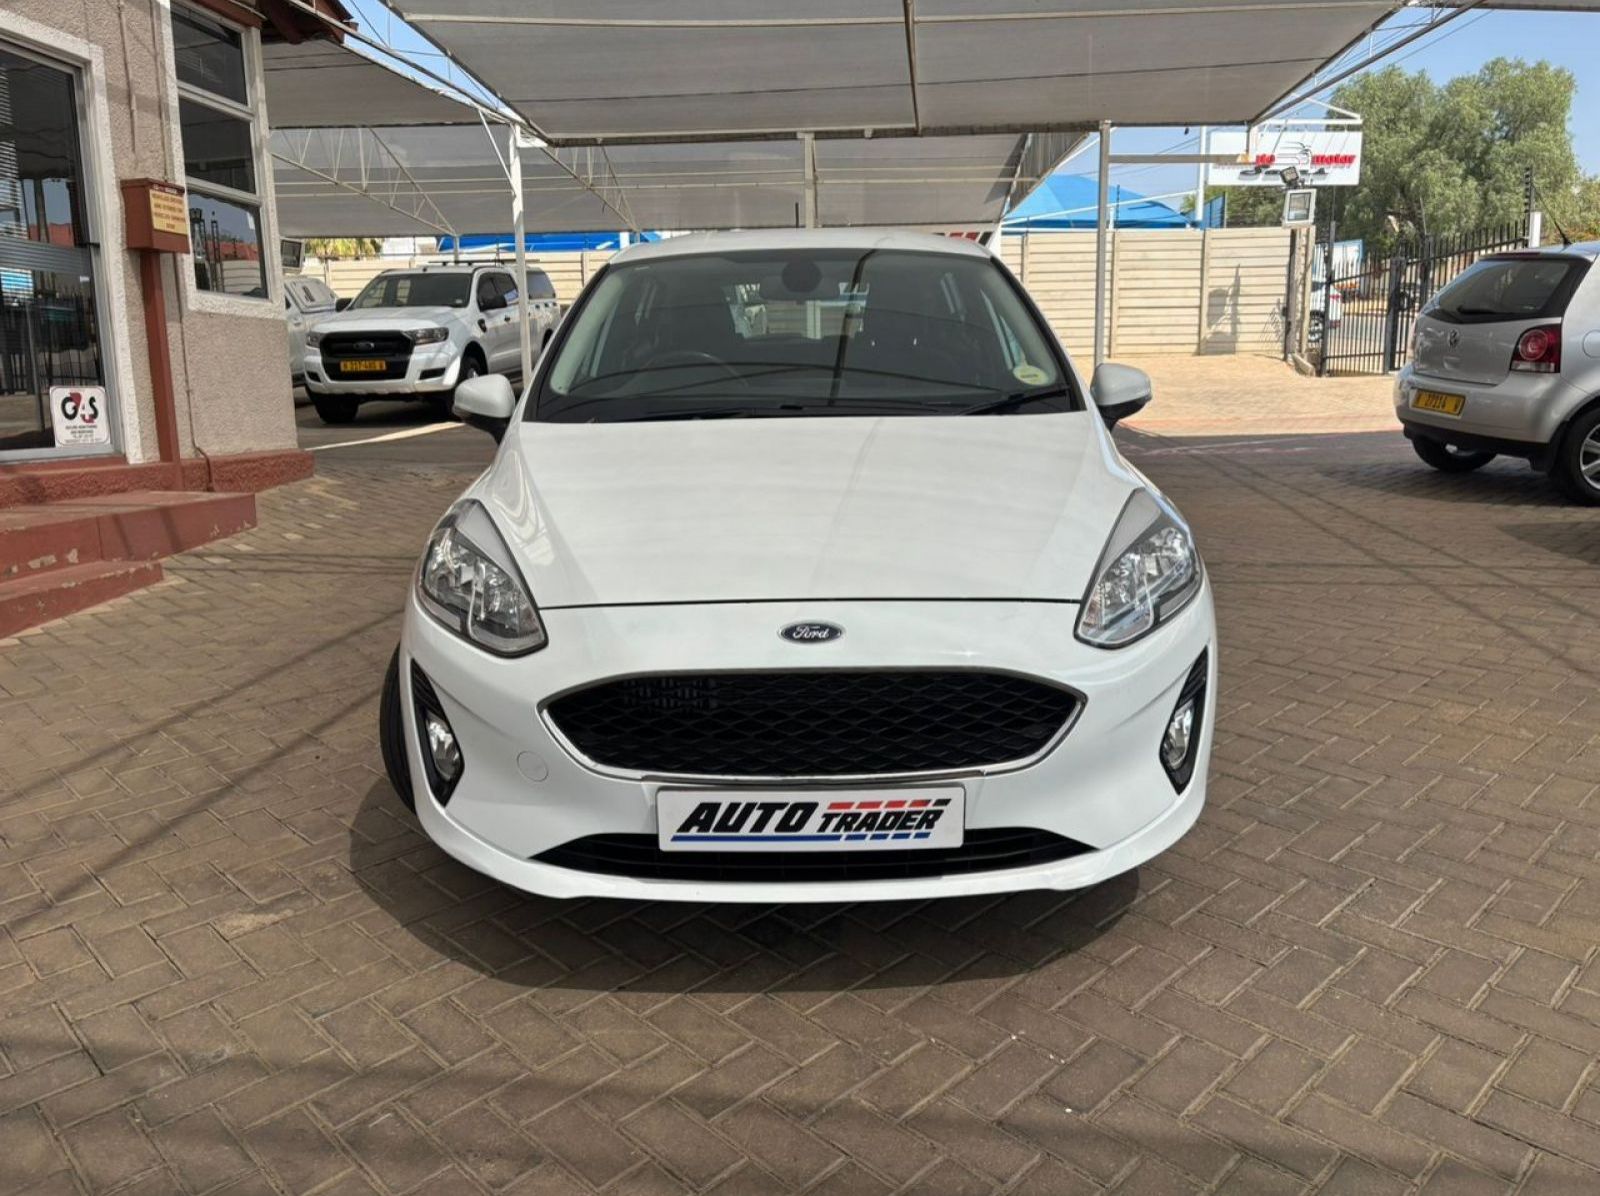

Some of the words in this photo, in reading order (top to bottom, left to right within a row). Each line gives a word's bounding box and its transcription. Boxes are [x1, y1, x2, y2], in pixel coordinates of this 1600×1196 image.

[792, 625, 830, 639] Ford
[676, 802, 819, 833] AUTO
[817, 809, 944, 833] TRADER
